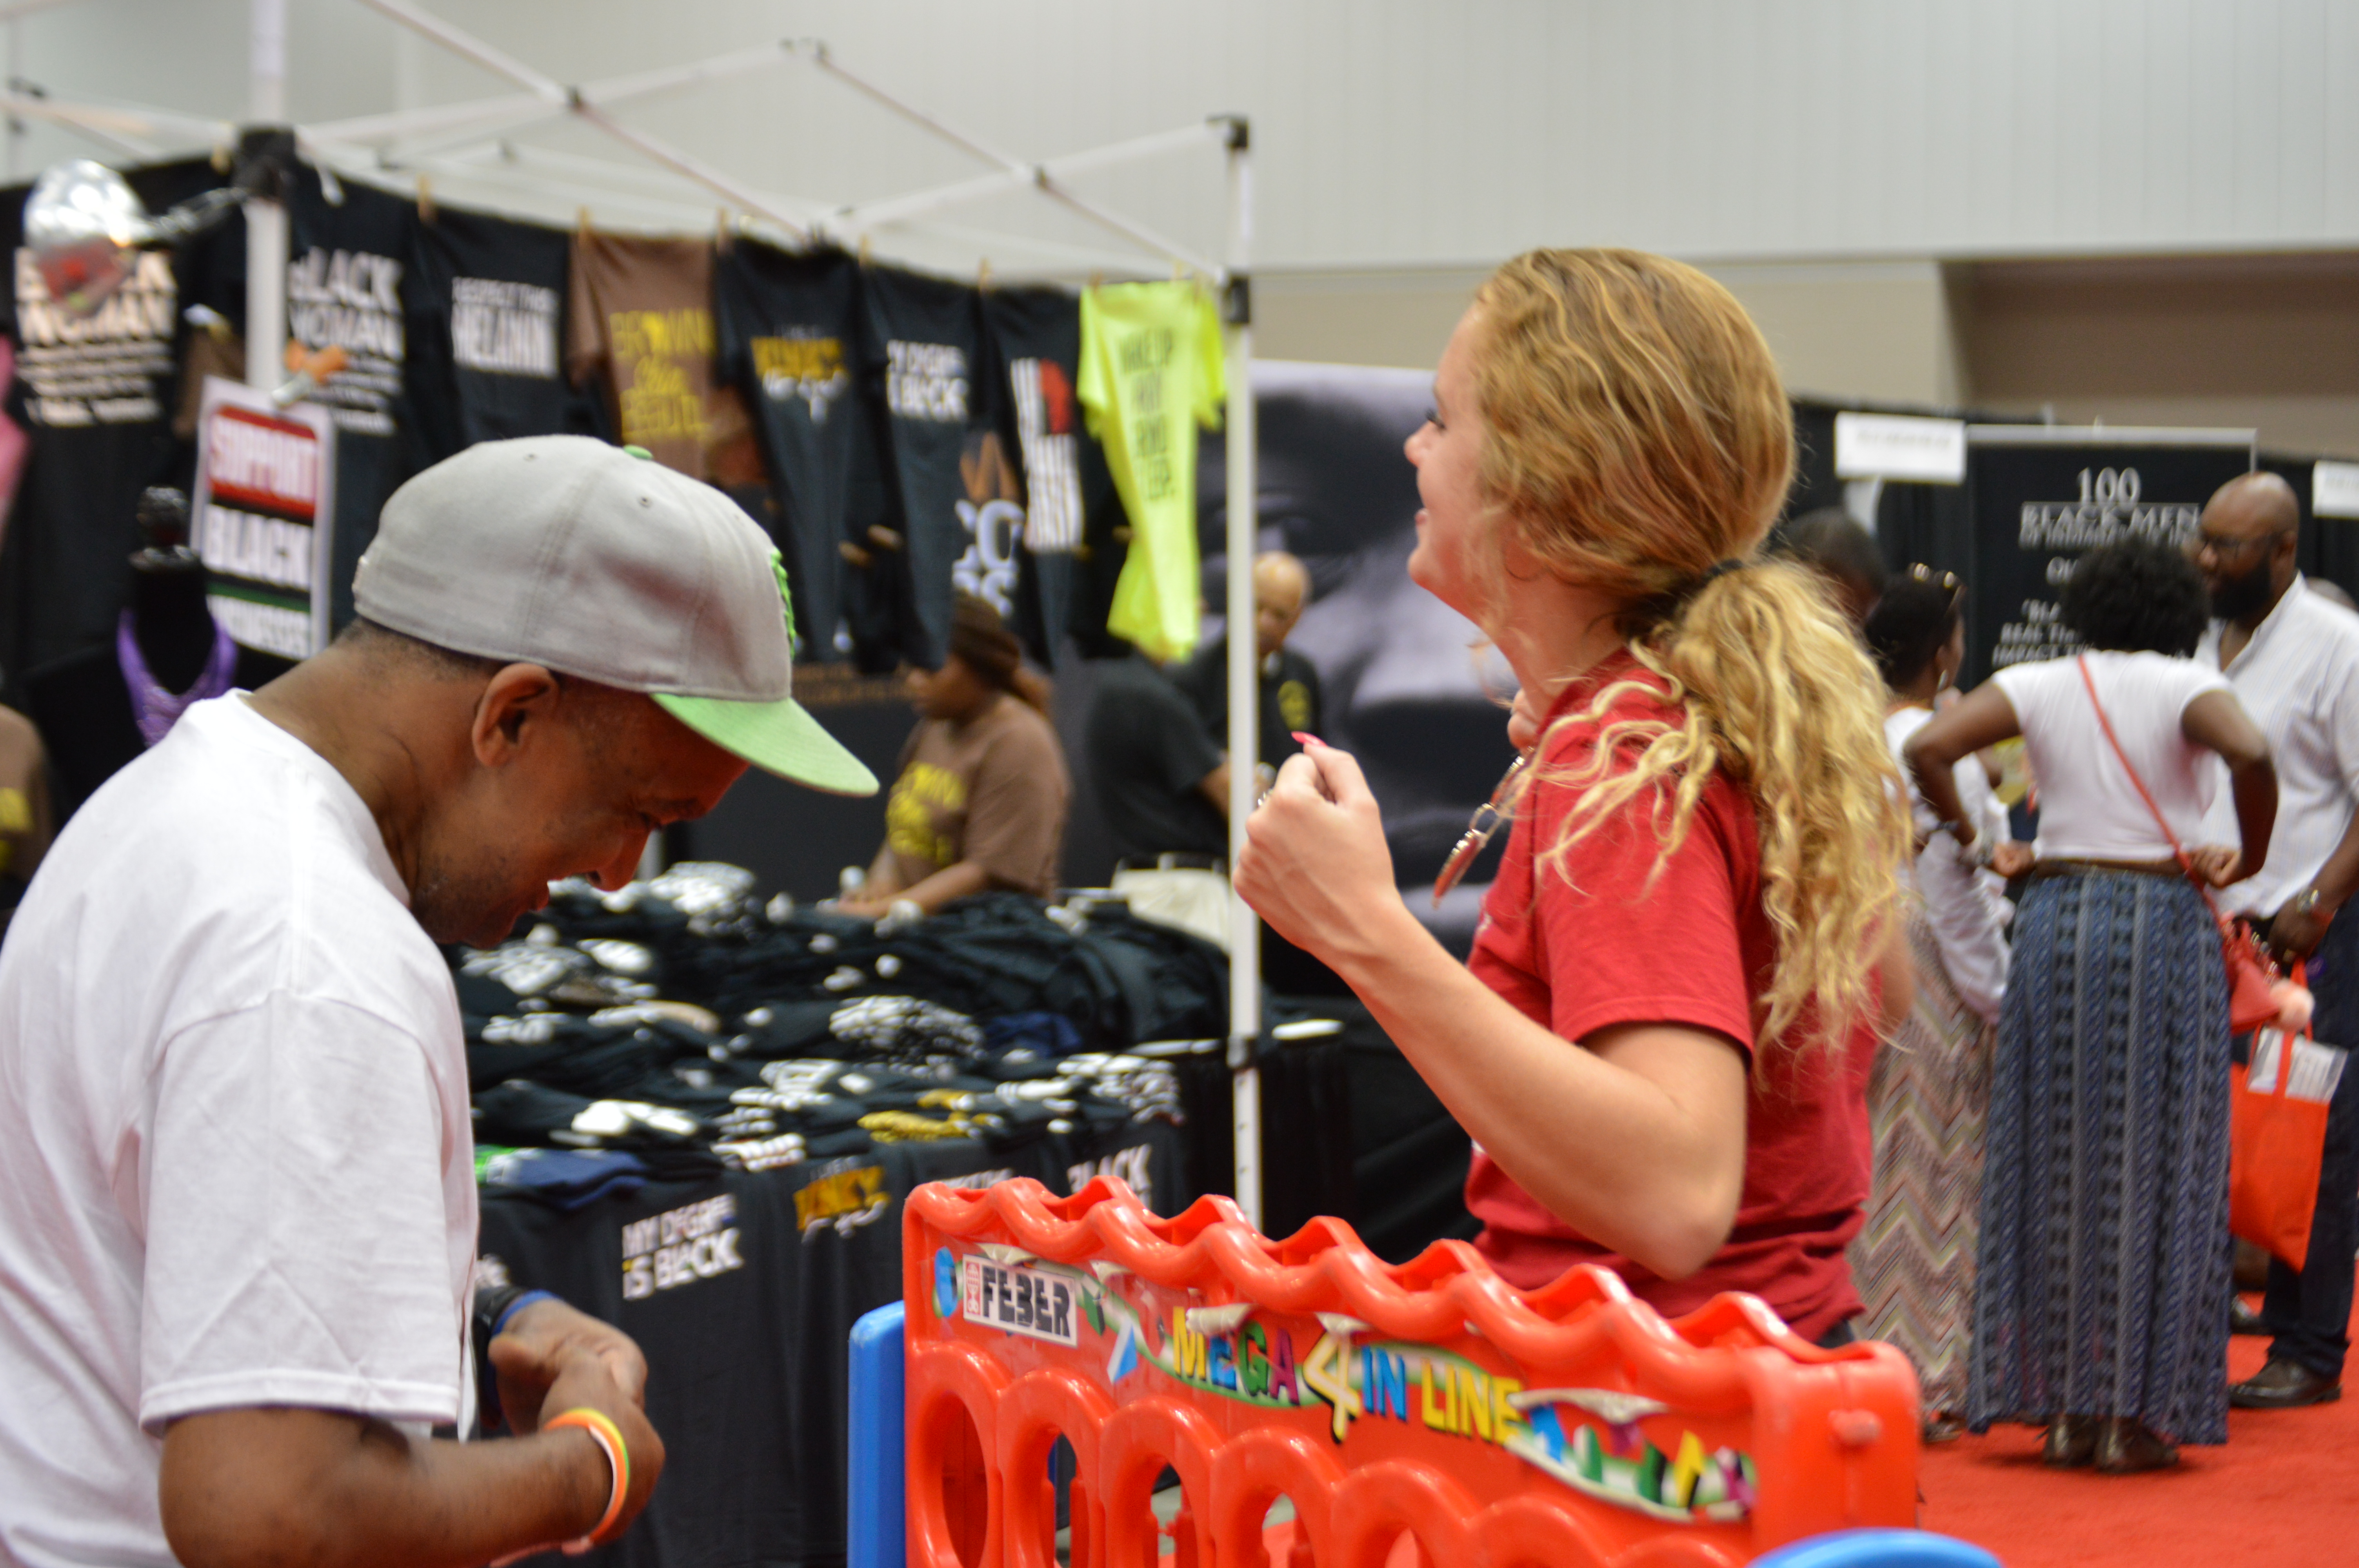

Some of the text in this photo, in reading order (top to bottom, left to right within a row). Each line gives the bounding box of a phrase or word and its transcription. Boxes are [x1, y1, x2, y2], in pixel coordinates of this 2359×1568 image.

[2077, 466, 2142, 512] 100
[653, 1227, 745, 1290] BLACK
[981, 1265, 1071, 1338] FEBER
[1172, 1305, 1524, 1447] MEGA 4 IN LINE
